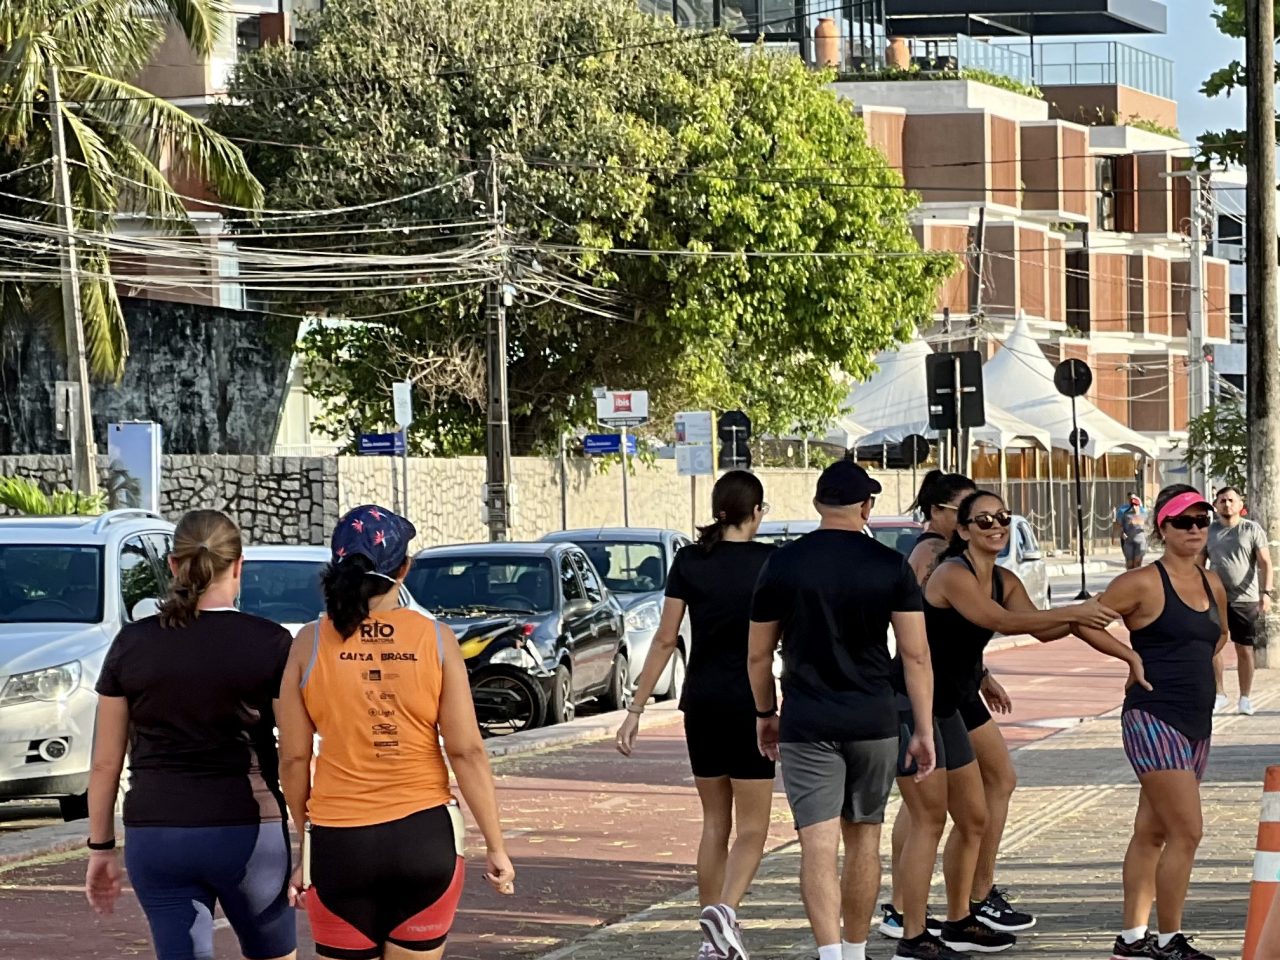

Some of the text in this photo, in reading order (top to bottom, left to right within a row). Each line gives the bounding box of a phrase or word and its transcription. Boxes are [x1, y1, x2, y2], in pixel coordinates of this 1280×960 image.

[615, 398, 630, 407] ibis
[361, 621, 395, 638] RIO
[340, 652, 418, 662] CAIXA BRASIL
[980, 905, 1001, 918] FILA
